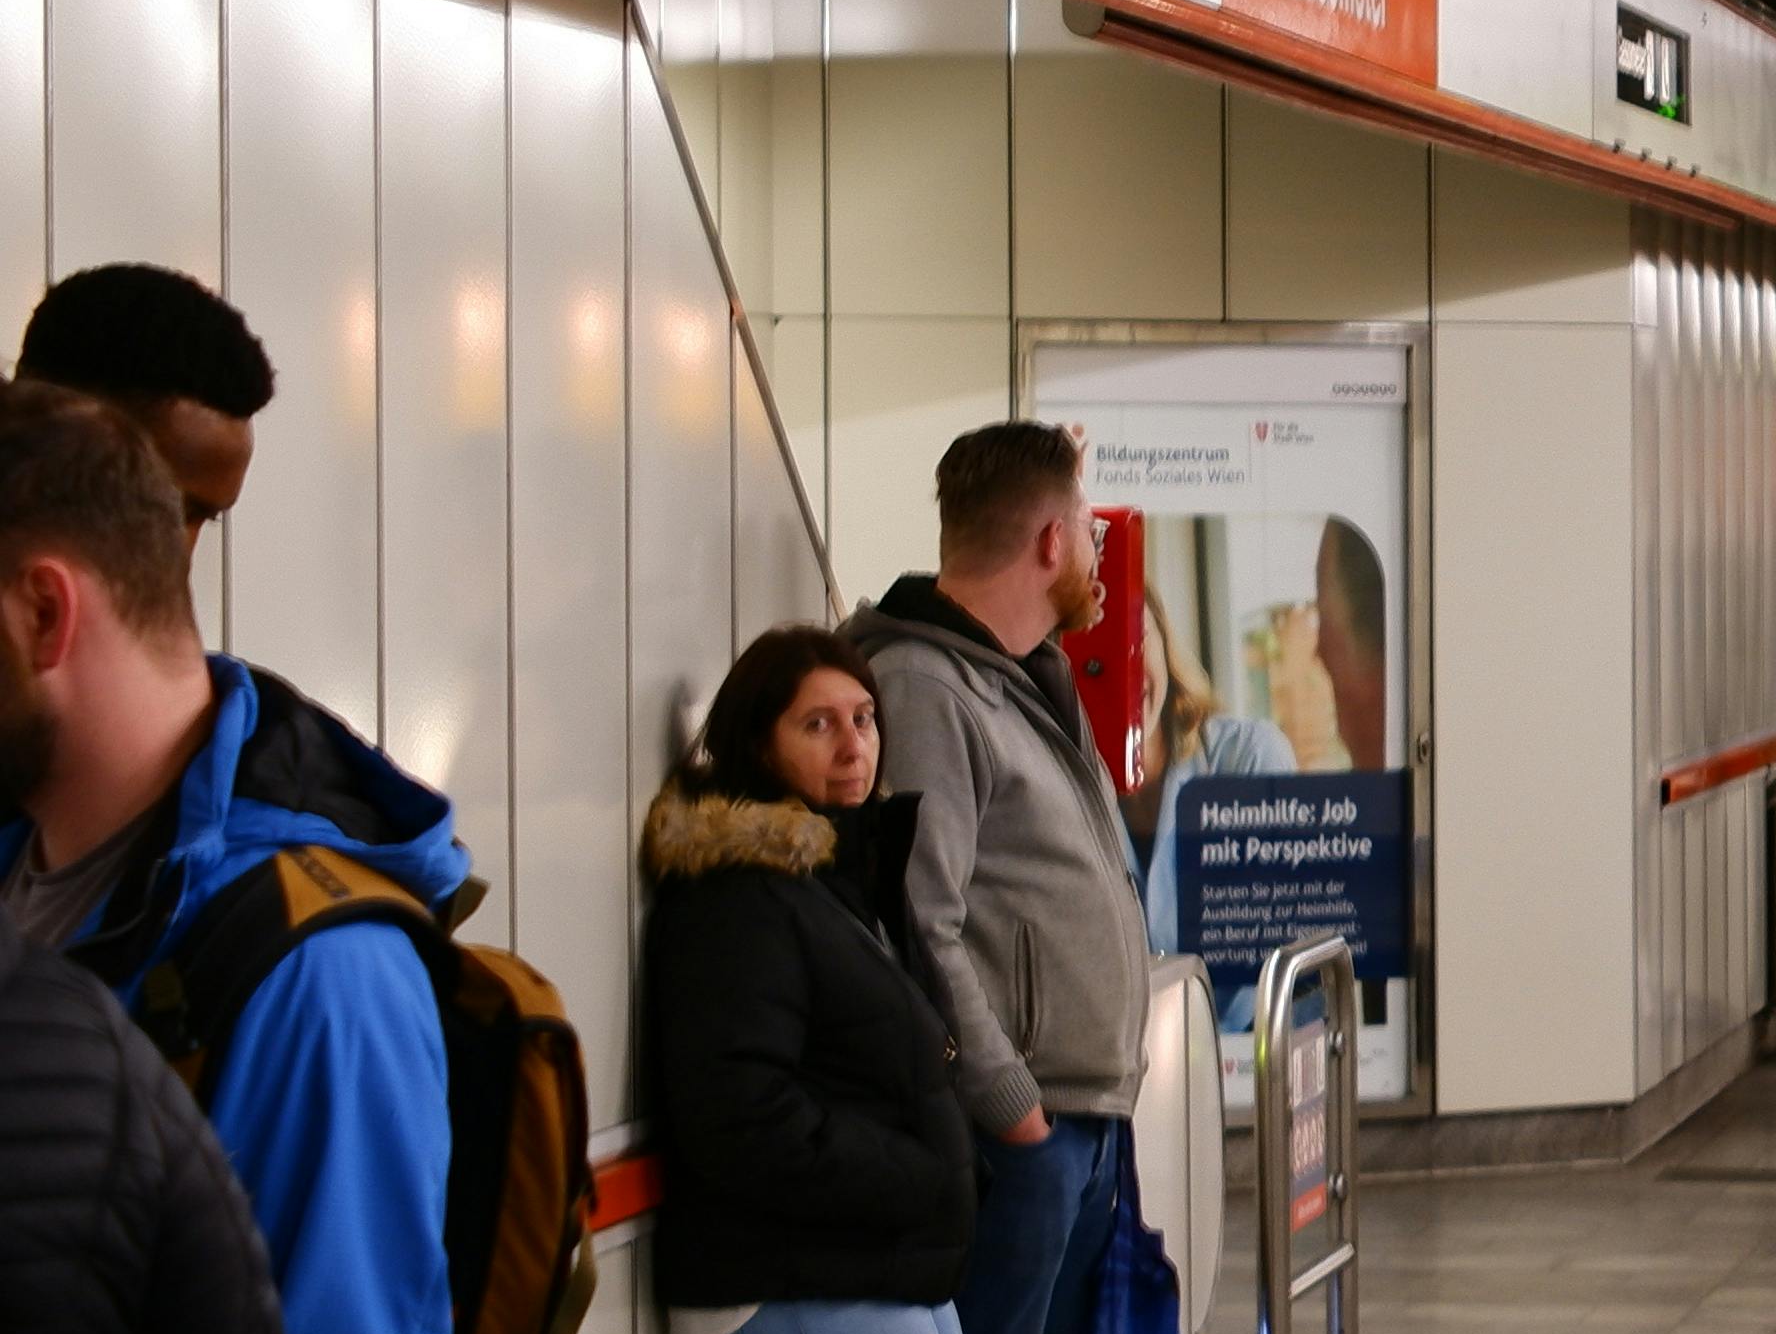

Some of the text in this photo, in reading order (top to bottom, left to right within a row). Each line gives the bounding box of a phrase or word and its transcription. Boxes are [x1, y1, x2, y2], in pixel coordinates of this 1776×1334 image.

[1096, 444, 1230, 468] Bildungszentrum
[1095, 468, 1246, 485] Fonds Soziales Wien
[1201, 795, 1358, 830] Heimhilfe: Job
[1201, 832, 1373, 870] mit Perspektive
[1202, 879, 1345, 900] Starten Sie jetzt mit der
[1202, 900, 1357, 921] Ausbildung zur Heimhilfe,
[1202, 926, 1222, 942] ein
[1225, 924, 1260, 940] Beruf
[1263, 923, 1284, 938] mit
[1202, 947, 1257, 965] wortung
